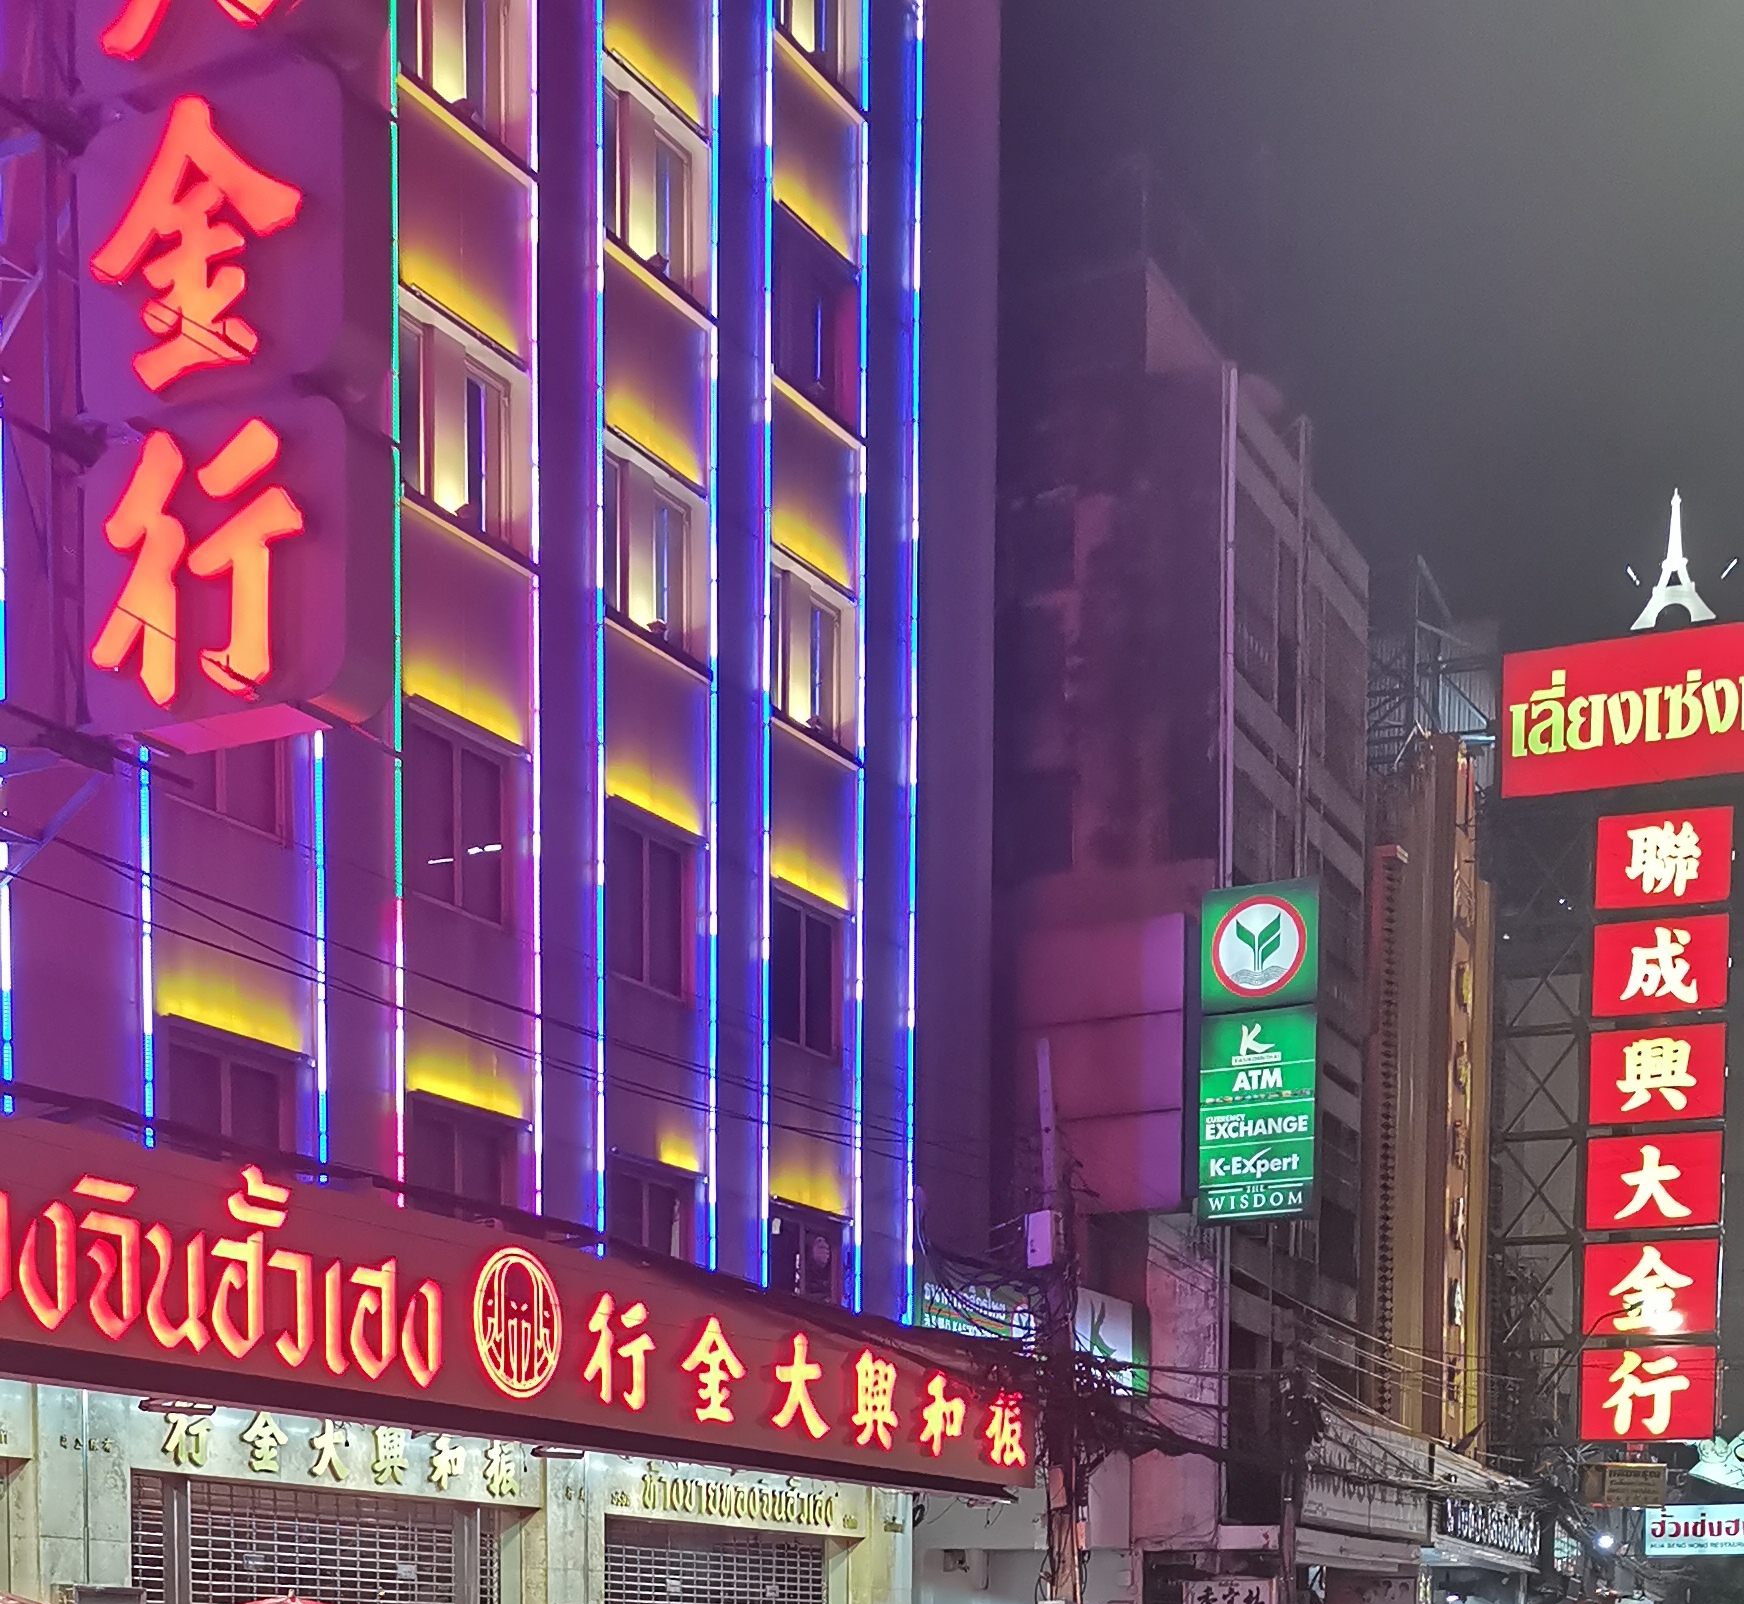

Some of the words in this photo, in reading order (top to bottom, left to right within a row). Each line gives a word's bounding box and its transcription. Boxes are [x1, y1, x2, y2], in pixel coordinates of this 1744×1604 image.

[91, 0, 305, 708] 金行
[1509, 668, 1744, 757] เลี่ยงเซ่ง
[1232, 1067, 1283, 1091] ATM
[1206, 1115, 1309, 1140] EXCHANGE
[1602, 820, 1702, 1436] 聯成興大金行
[1210, 1147, 1299, 1178] K-Expert
[1208, 1191, 1303, 1211] WISDOM
[1246, 1184, 1265, 1193] THE
[0, 1164, 443, 1388] งจินฮั้วเฮง
[1651, 1507, 1744, 1538] ฮั้วเซ่งฮ
